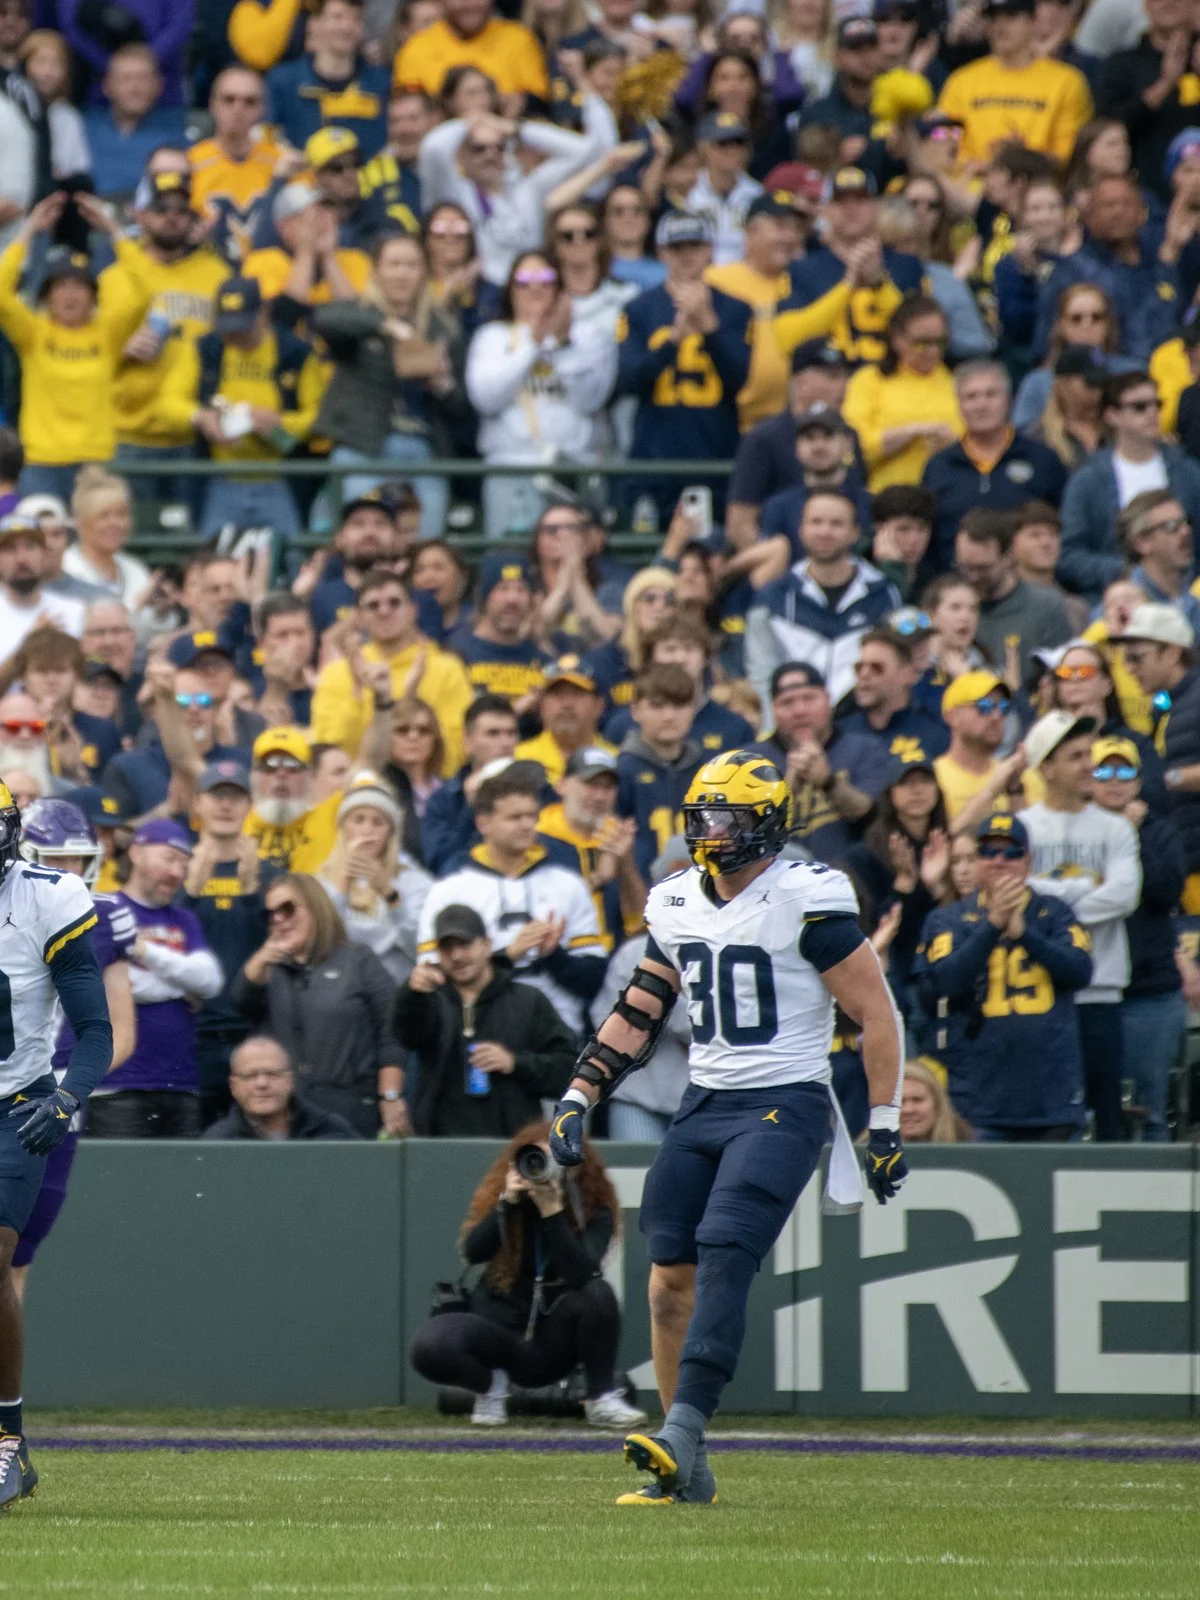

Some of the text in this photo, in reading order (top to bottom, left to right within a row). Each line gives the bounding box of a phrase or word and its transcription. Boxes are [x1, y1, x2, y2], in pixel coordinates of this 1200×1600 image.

[677, 942, 779, 1046] 30
[982, 945, 1055, 1017] 15
[604, 1167, 1200, 1394] IRE
